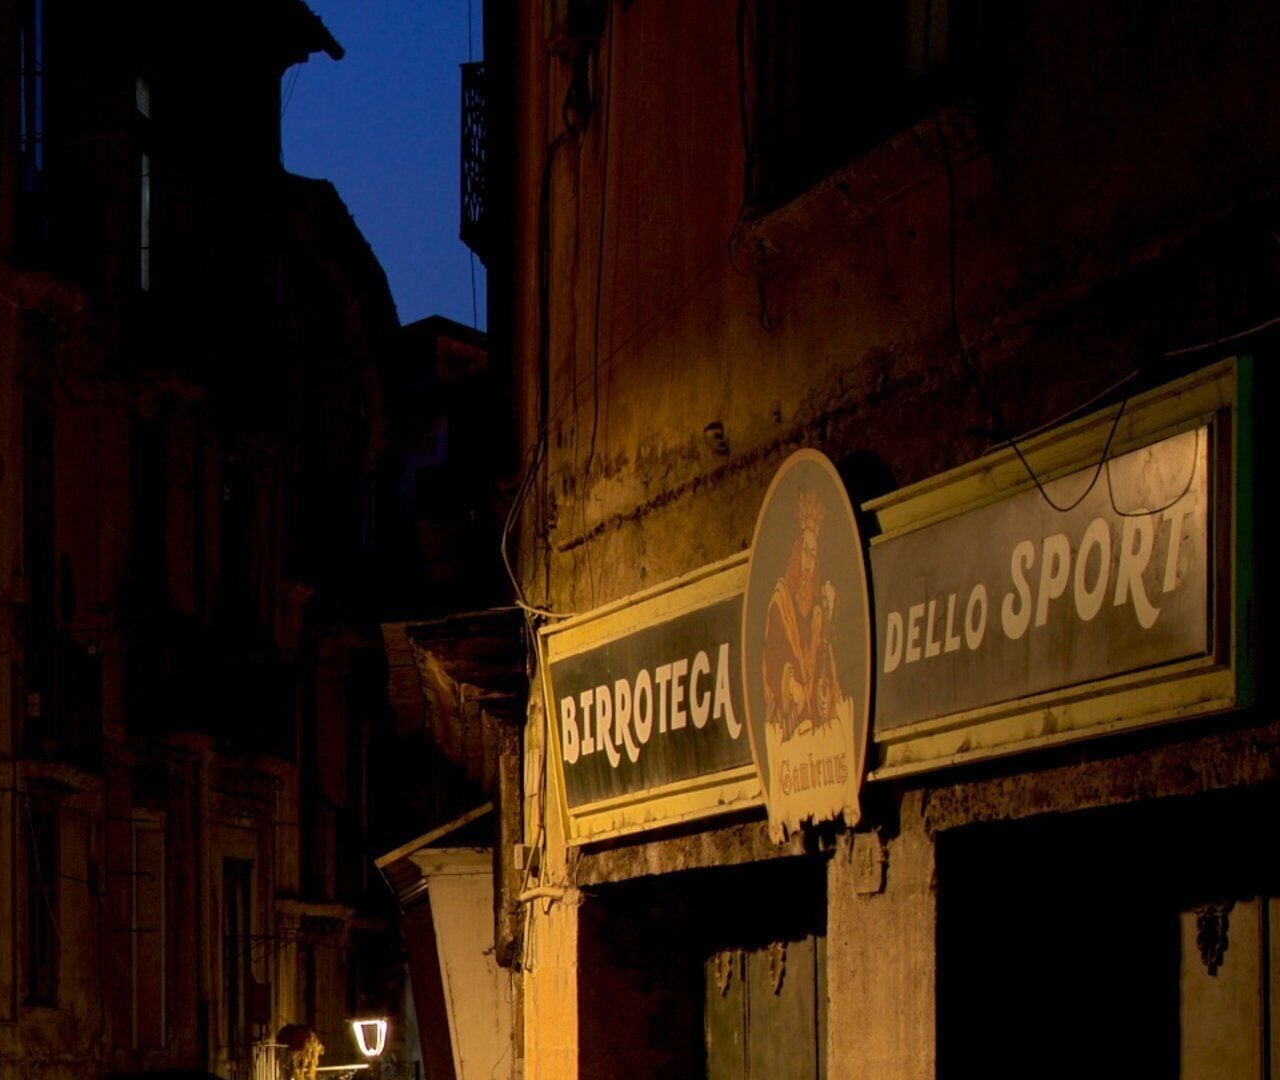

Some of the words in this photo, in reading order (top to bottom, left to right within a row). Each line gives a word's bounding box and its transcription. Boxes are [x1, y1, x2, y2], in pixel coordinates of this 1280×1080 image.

[561, 642, 743, 768] BIRROTECA
[883, 583, 988, 674] DELLO
[1001, 494, 1196, 640] SPORT
